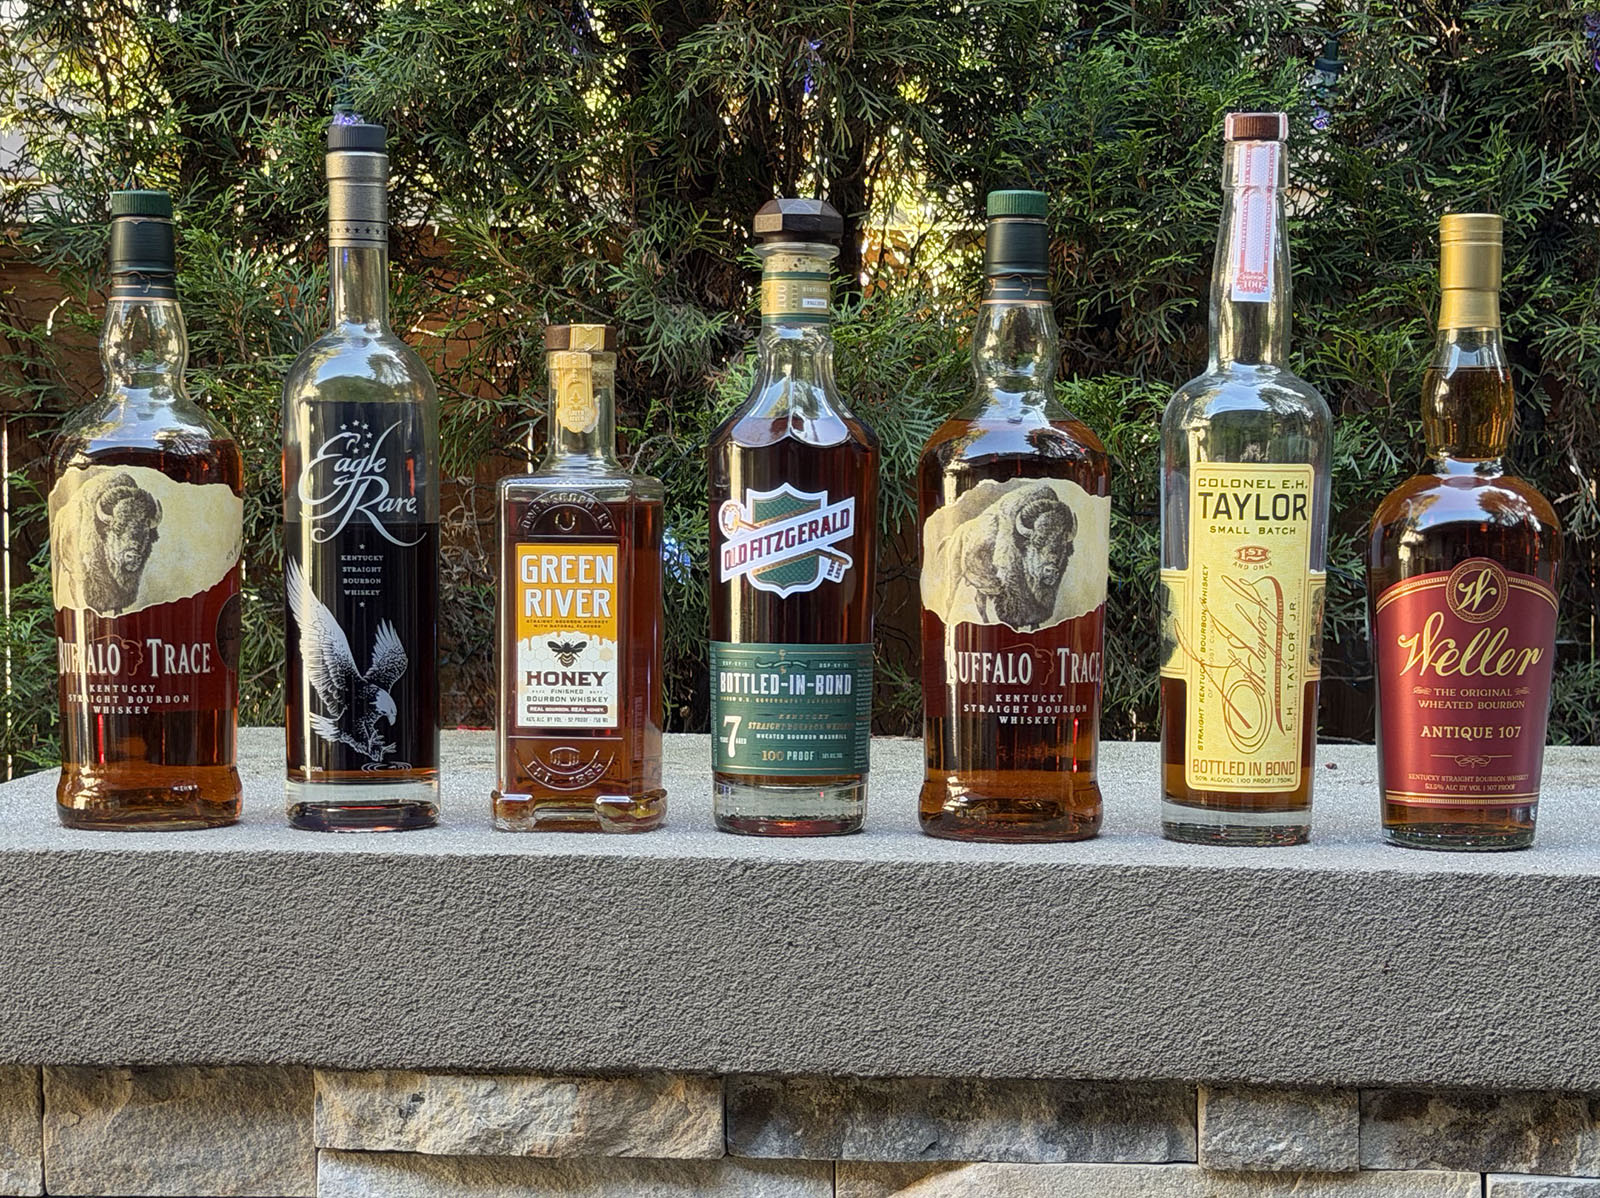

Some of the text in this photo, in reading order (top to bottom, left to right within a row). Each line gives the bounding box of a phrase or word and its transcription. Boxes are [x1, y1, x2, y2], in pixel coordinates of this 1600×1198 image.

[1198, 478, 1308, 490] COLONEL E.H.
[1198, 492, 1307, 521] TAYLOR
[1209, 525, 1296, 535] SMALL BATCH
[724, 508, 850, 570] OLD FITZGERALD
[521, 555, 614, 584] GREEN
[1200, 564, 1209, 606] WHISKEY
[1456, 569, 1497, 612] W
[525, 589, 612, 618] RIVER
[1200, 609, 1208, 653] BOURBON
[1398, 611, 1544, 677] Weller
[147, 639, 211, 677] TRACE
[1286, 632, 1295, 689] TAYLOR
[946, 647, 1100, 686] BUFFALO TRACE
[526, 671, 609, 687] HONEY
[720, 672, 852, 695] BOTTLED-IN-BOND
[89, 684, 156, 693] KENTUCKY
[1434, 688, 1513, 697] THE ORIGINAL
[128, 694, 190, 703] BOURBON
[526, 695, 566, 703] BOURBON
[995, 694, 1063, 703] KENTUCKY
[1418, 700, 1525, 710] WHEATED BOURBON
[93, 705, 150, 714] WHISKEY
[963, 703, 1087, 713] STRAIGHT BOURBON
[999, 716, 1057, 725] WHISKEY
[723, 715, 742, 758] 7
[1197, 707, 1205, 751] STRAIGHT
[1420, 725, 1522, 741] ANTIQUE 107
[762, 750, 785, 761] 100
[787, 751, 815, 761] PROOF
[1192, 759, 1296, 776] BOTTLED IN BOND
[1408, 773, 1440, 781] KENTUCKY
[1442, 775, 1475, 783] STRAIGHT
